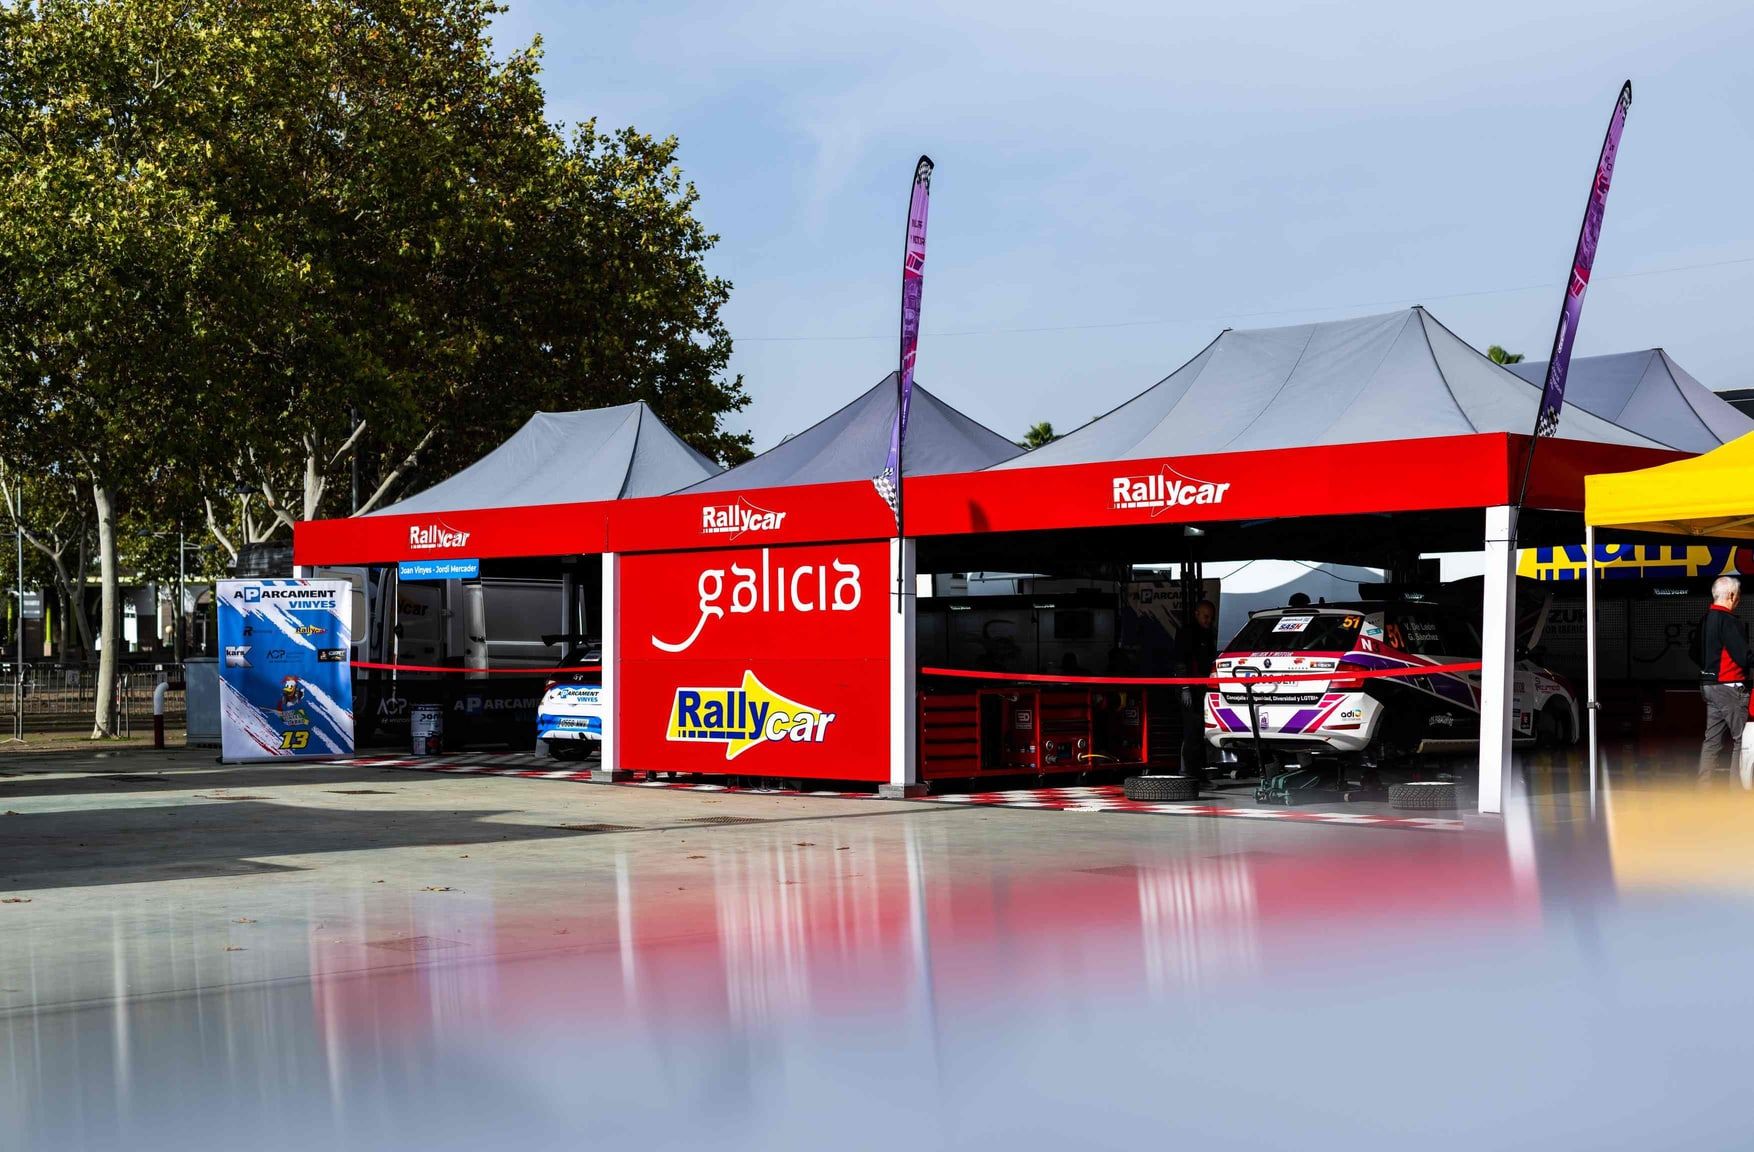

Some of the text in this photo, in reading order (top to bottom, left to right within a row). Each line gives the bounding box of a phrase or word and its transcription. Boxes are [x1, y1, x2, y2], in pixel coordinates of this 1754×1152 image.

[1113, 475, 1231, 506] Rallycar
[702, 505, 787, 531] Rallycar
[410, 524, 470, 548] Rallycar
[400, 566, 414, 575] Joan
[414, 566, 432, 575] Vinyes
[436, 564, 449, 573] Jordi
[450, 564, 477, 573] Mercader
[233, 587, 336, 603] APARCAMENT
[288, 601, 336, 609] VINYES
[651, 547, 862, 653] galicia
[1342, 615, 1360, 629] 51
[678, 690, 836, 743] Rallycar
[279, 730, 309, 750] 13
